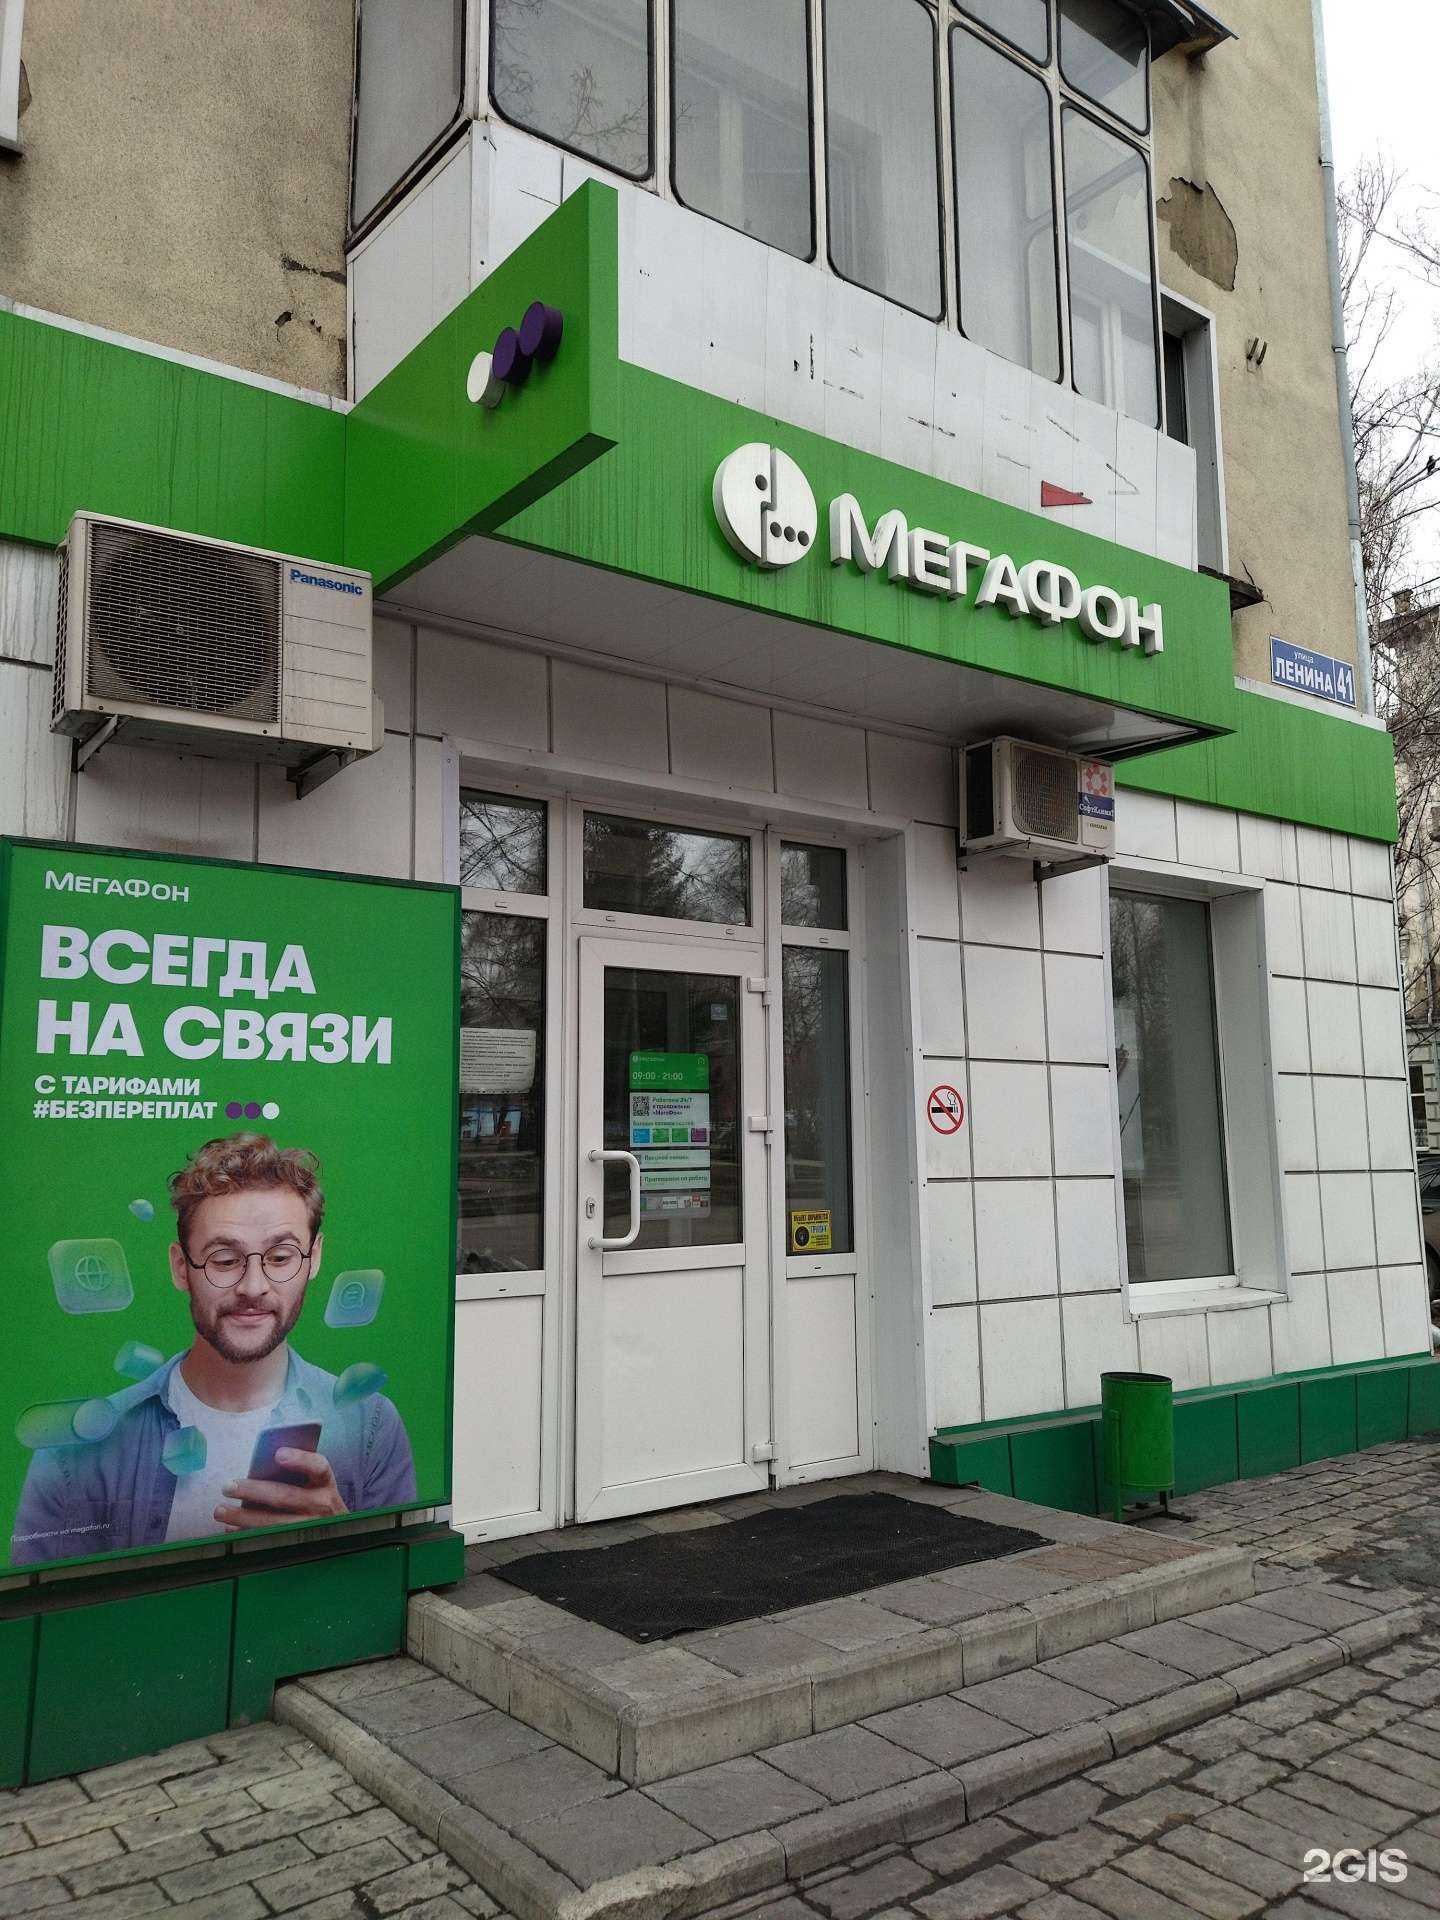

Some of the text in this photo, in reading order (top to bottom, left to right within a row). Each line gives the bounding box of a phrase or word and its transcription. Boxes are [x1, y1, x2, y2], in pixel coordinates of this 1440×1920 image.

[290, 568, 363, 596] Panasonic
[829, 493, 1164, 656] МЕГАФОН
[1275, 657, 1354, 702] ЛЕНИНА 41
[44, 870, 190, 903] МЕГАФОН
[40, 925, 318, 1000] ВСЕГДА
[36, 999, 145, 1057] НА
[163, 1005, 393, 1065] СВЯЗИ
[34, 1075, 201, 1097] С ТАРИФАМИ
[632, 1071, 656, 1081] 09:00
[662, 1072, 684, 1081] 21:00
[33, 1100, 218, 1121] #БЕЗПЕРЕПЛАТ
